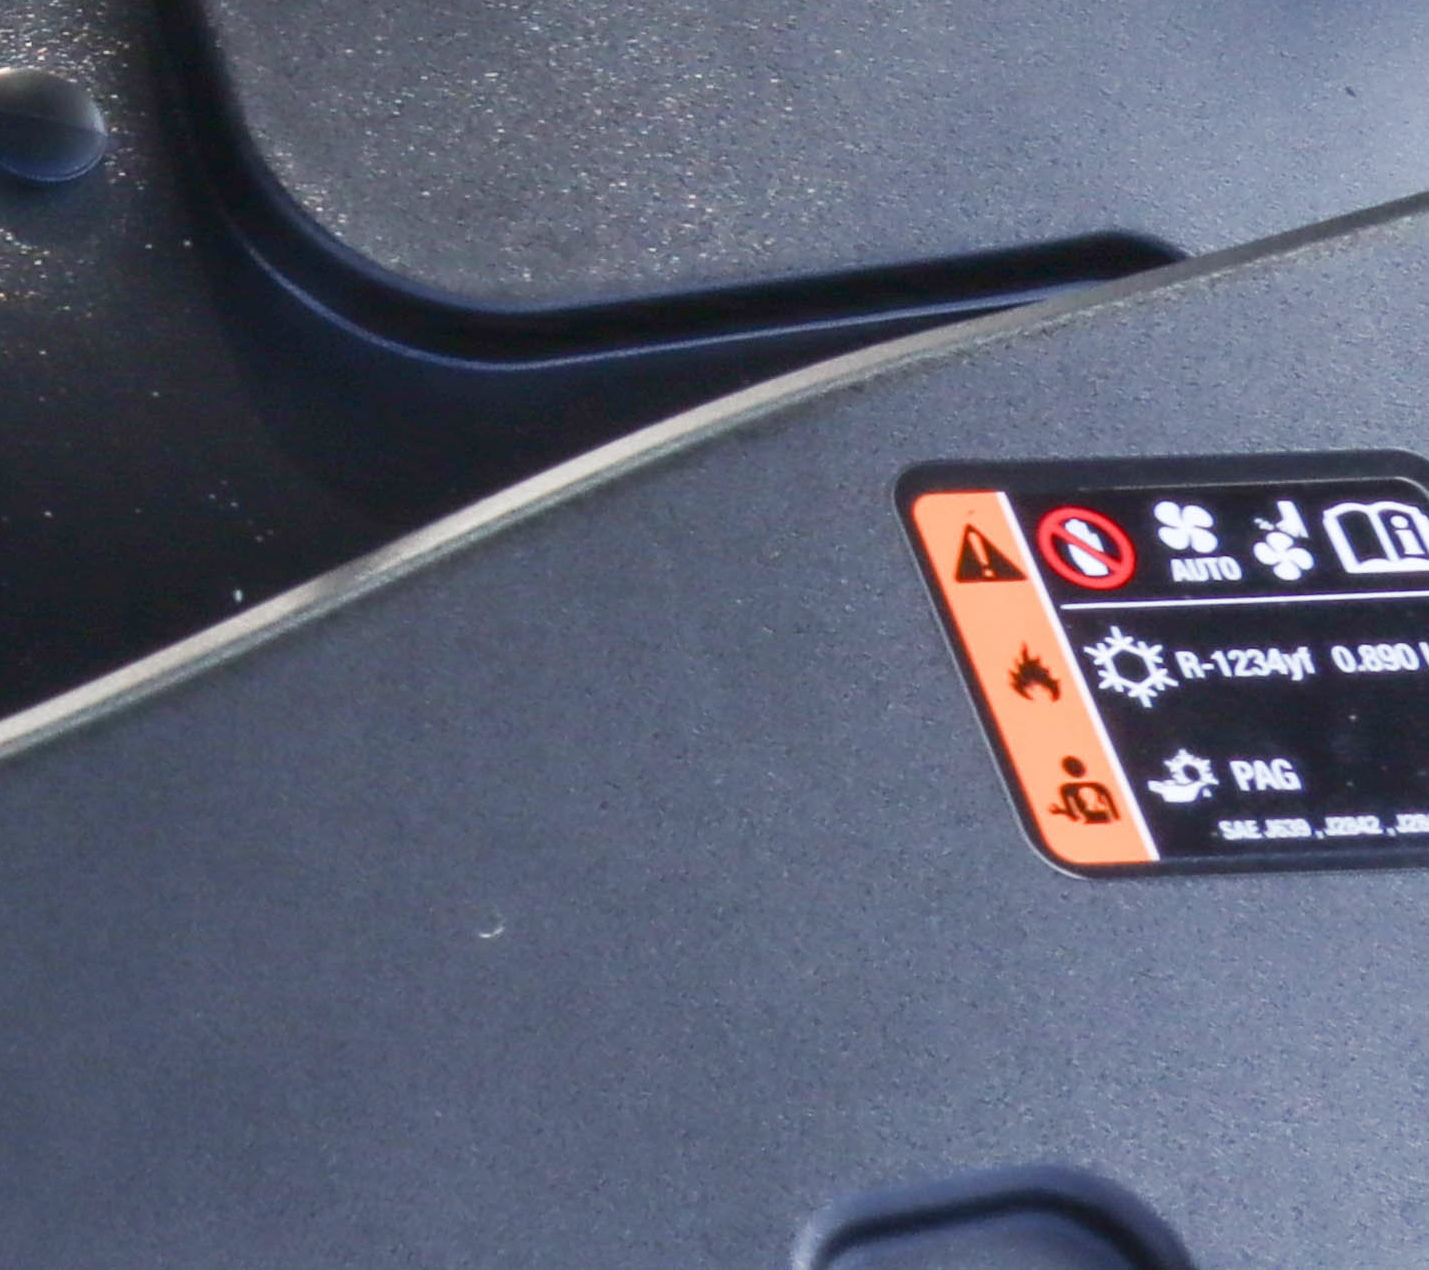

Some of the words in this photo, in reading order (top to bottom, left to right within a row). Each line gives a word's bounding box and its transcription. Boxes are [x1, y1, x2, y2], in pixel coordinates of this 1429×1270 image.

[1171, 556, 1242, 582] AUTO
[1174, 647, 1315, 681] R-1234yf
[1331, 643, 1420, 673] 0.890
[1230, 759, 1302, 791] PAG
[1219, 819, 1263, 840] SAE
